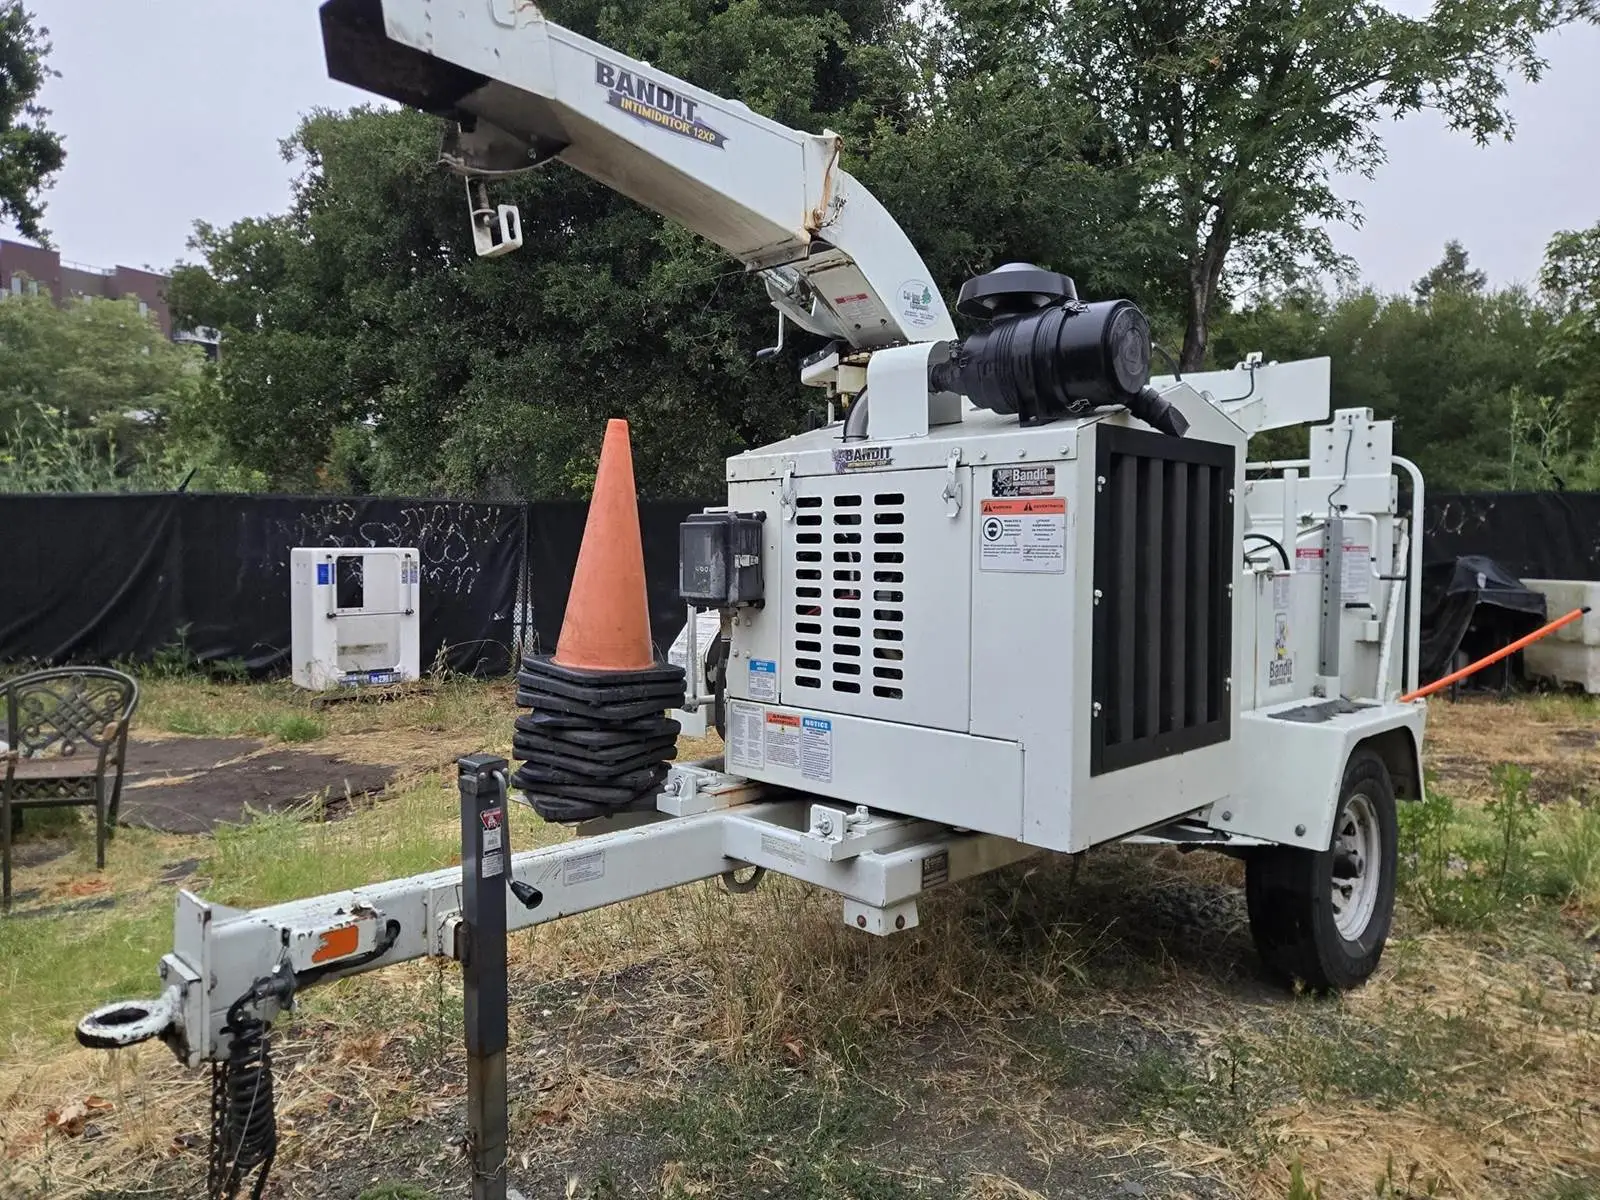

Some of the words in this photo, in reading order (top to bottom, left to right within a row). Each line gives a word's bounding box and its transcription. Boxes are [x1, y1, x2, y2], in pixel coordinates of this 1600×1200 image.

[595, 60, 698, 122] BANDIT
[694, 127, 716, 143] 12XP
[845, 446, 892, 461] BANDIT
[1012, 467, 1048, 481] Bandit
[1269, 659, 1293, 679] Bandit
[804, 719, 829, 729] NOTICE
